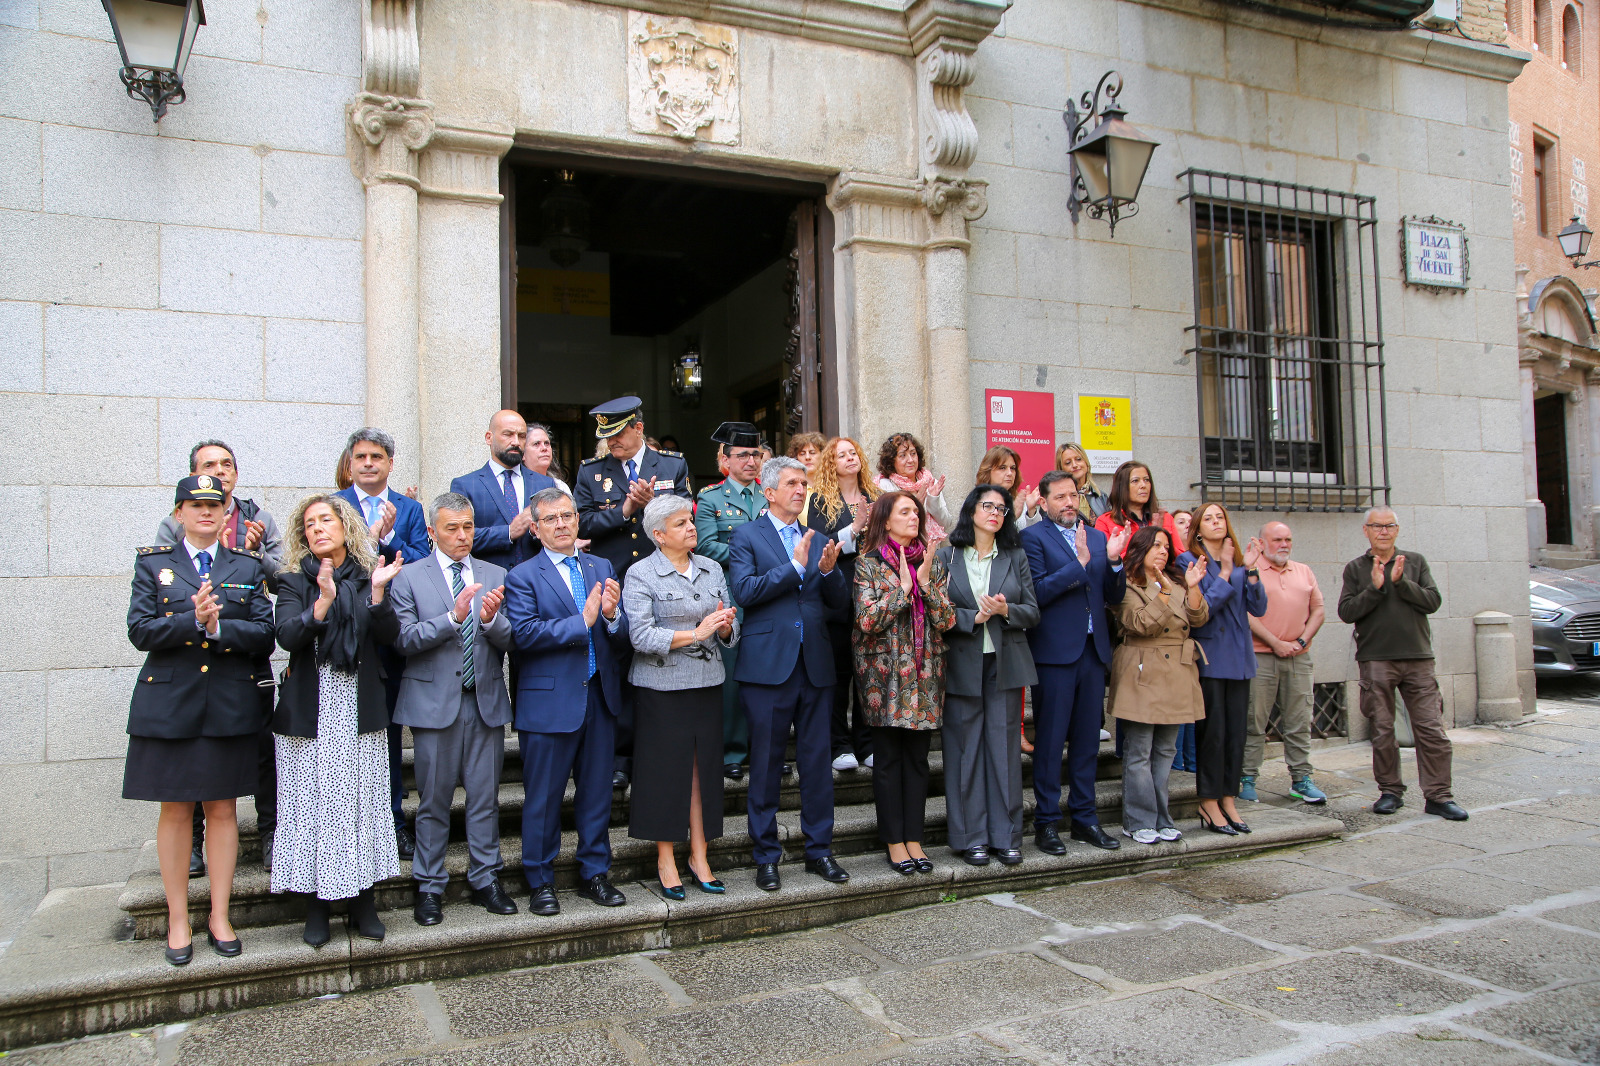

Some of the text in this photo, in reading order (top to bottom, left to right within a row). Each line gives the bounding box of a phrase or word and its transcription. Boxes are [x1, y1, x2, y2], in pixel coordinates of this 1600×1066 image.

[1420, 231, 1451, 249] PLAZA
[1423, 249, 1447, 260] DE SAN
[1415, 256, 1454, 275] VICENTE
